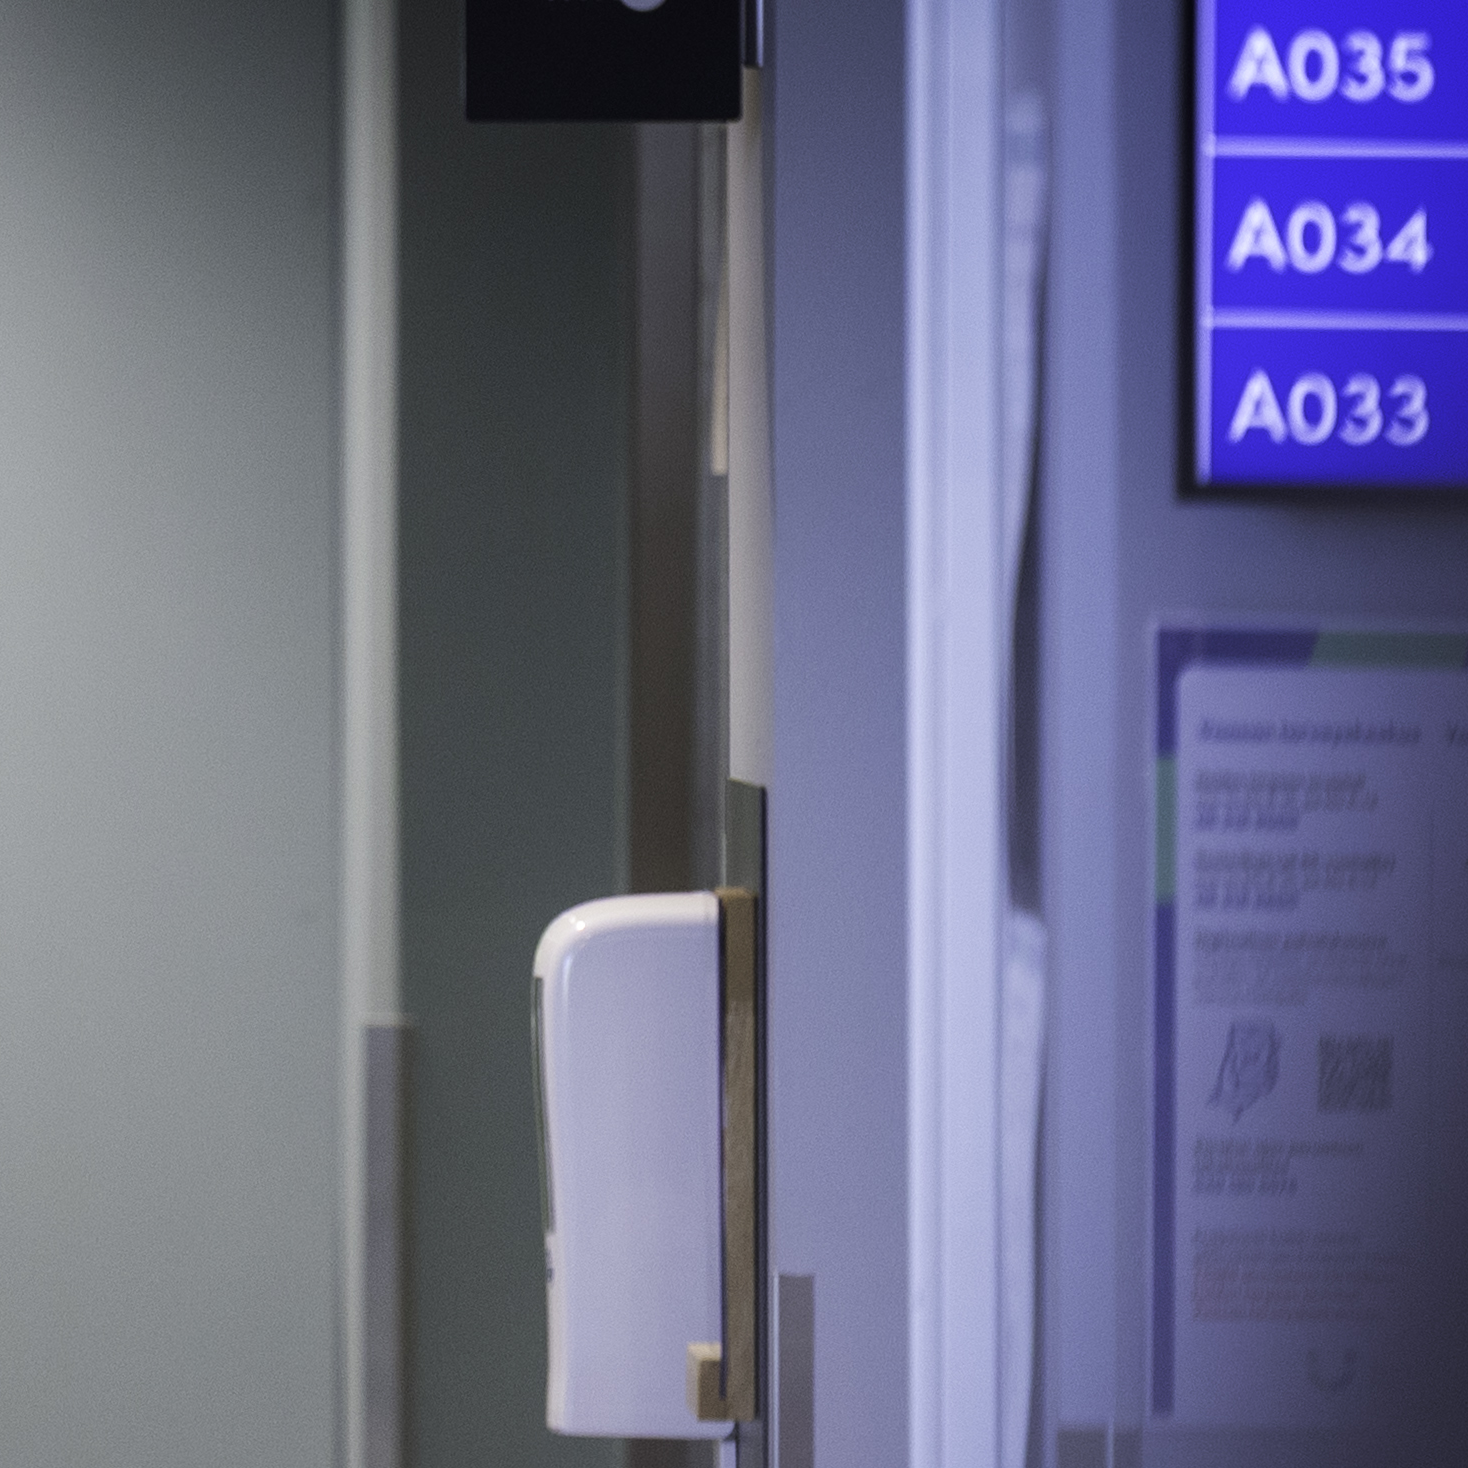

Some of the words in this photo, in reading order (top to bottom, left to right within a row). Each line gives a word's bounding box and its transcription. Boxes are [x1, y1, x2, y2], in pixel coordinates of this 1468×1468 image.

[1228, 24, 1434, 102] A035
[1226, 197, 1432, 274] A034
[1227, 367, 1429, 446] A033
